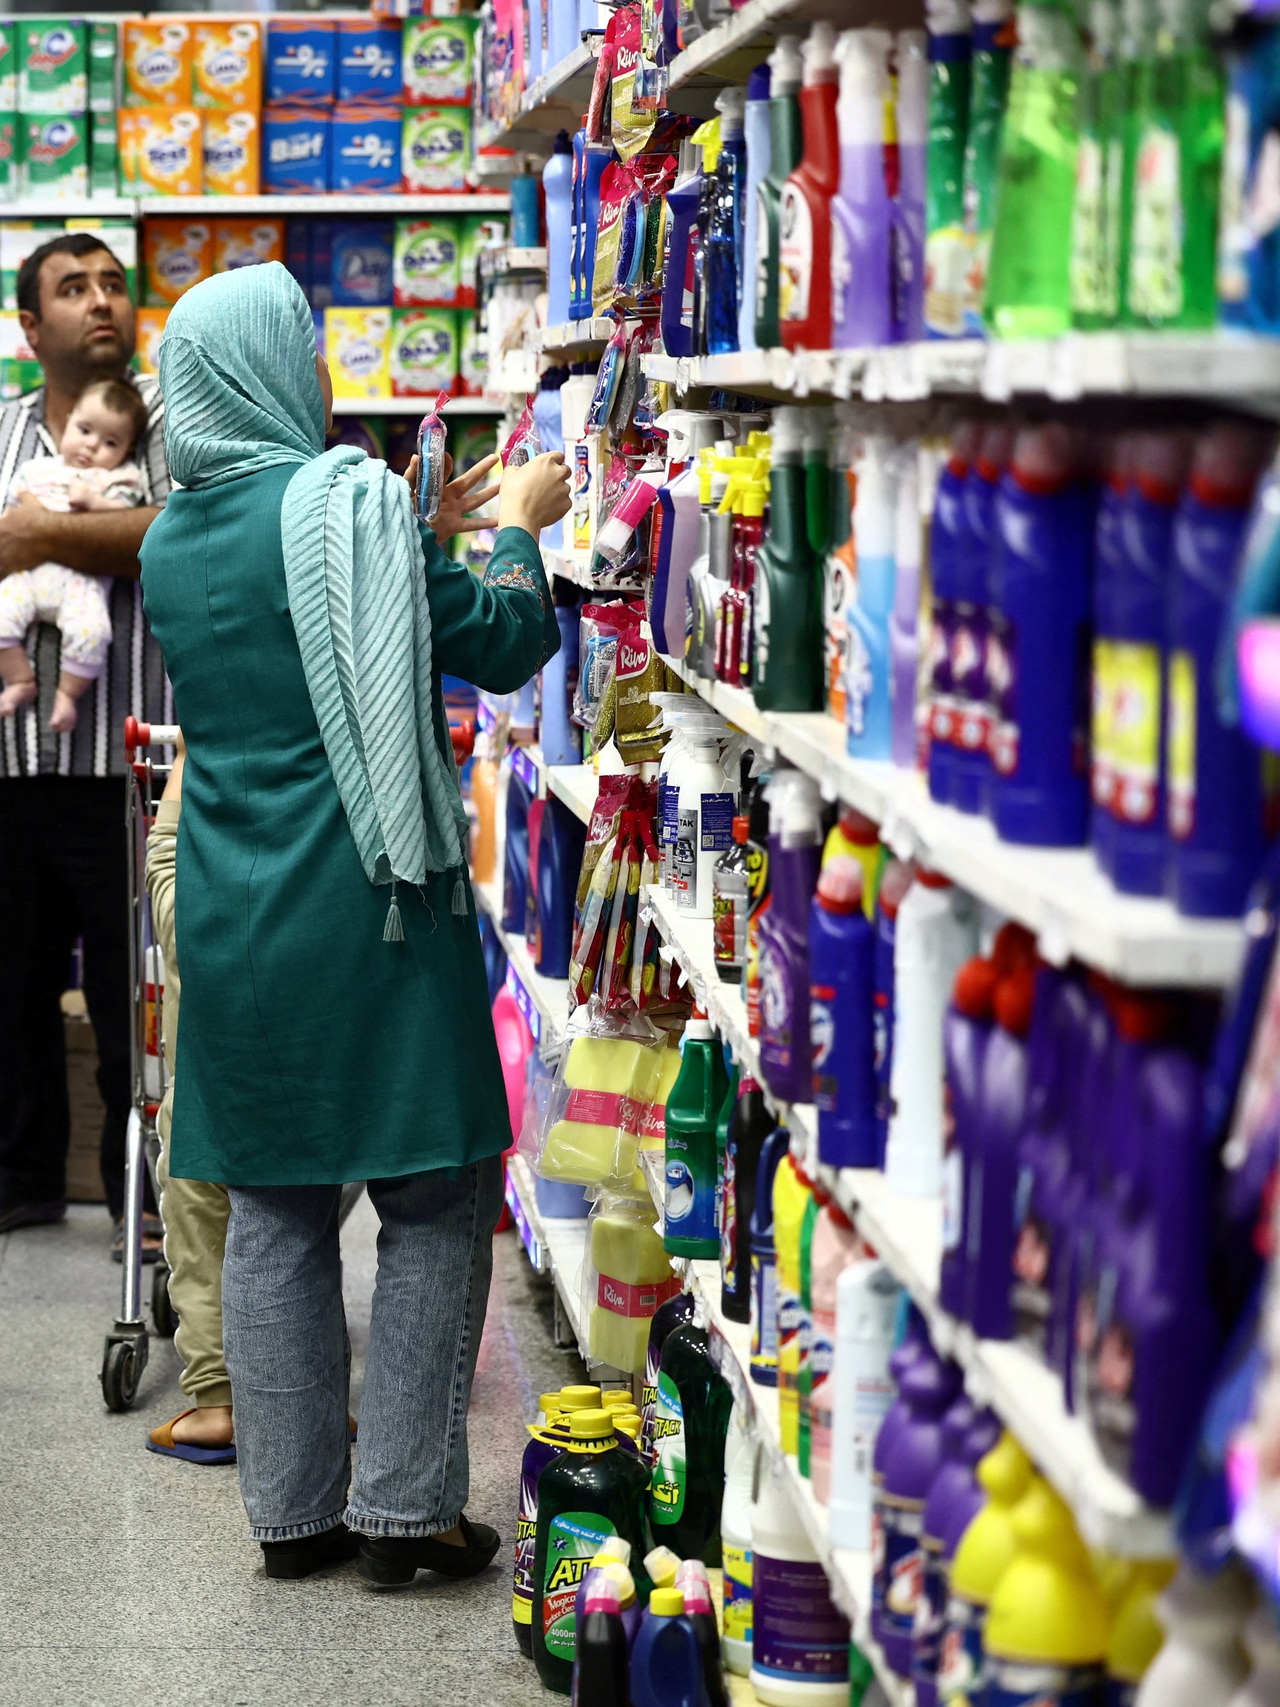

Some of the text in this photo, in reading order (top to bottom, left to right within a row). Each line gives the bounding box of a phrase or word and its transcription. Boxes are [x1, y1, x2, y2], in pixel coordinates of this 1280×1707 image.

[270, 132, 325, 163] Barf
[620, 644, 647, 670] Riva
[639, 1109, 666, 1130] Riva
[603, 1283, 626, 1306] Riva
[549, 1594, 576, 1611] Magica
[551, 1628, 577, 1638] 4000m
